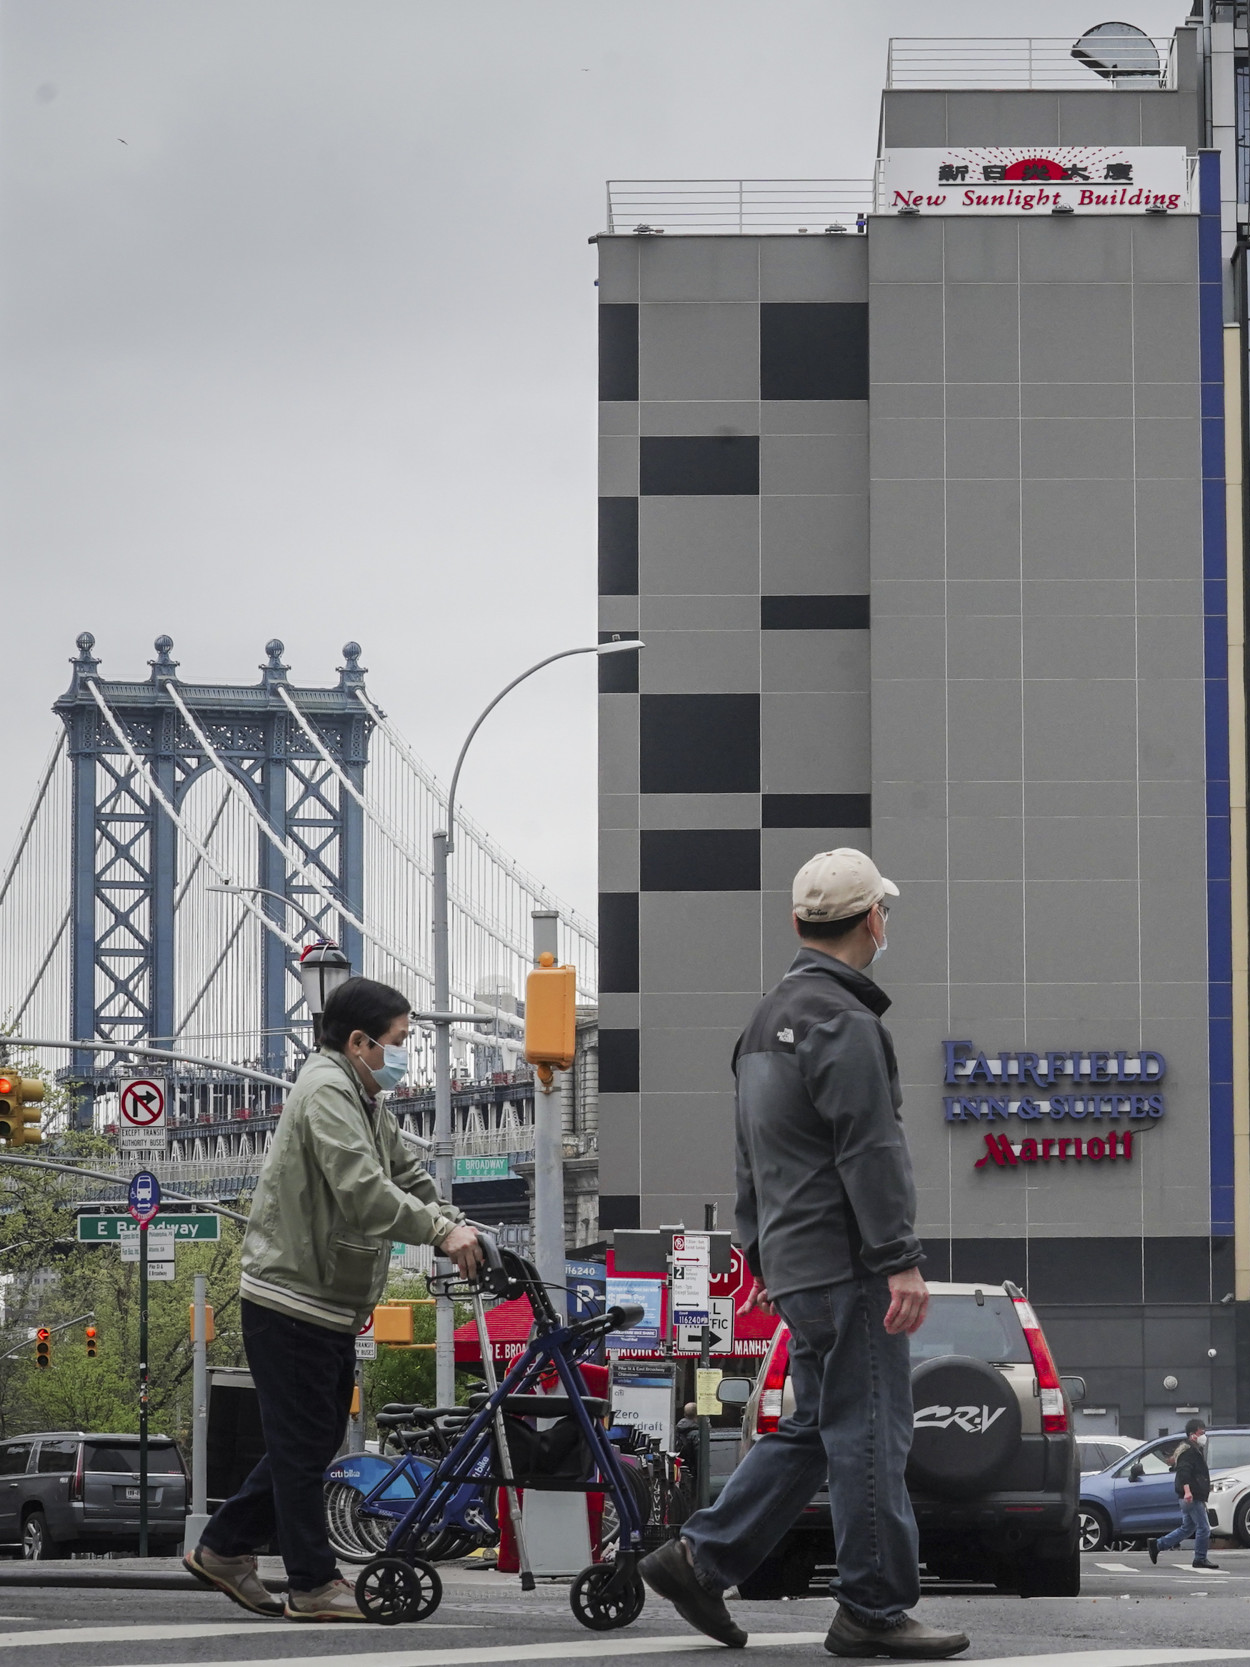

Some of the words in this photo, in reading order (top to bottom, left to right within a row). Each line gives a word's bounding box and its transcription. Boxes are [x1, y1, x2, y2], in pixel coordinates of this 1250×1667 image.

[892, 190, 947, 207] New
[962, 188, 1062, 210] Sunlight
[1078, 188, 1181, 210] Building
[943, 1096, 1011, 1120] INN
[1016, 1096, 1043, 1120] &
[1049, 1094, 1164, 1119] SUITES
[121, 1129, 141, 1137] EXCEPT
[143, 1129, 165, 1137] TRANSIT
[121, 1139, 147, 1147] AUTHORITY
[149, 1139, 165, 1147] BUSES
[974, 1130, 1133, 1168] Marriott
[456, 1160, 462, 1170] E
[465, 1159, 505, 1170] BROADWAY
[98, 1221, 108, 1235] E
[676, 1267, 682, 1278] 2
[615, 1409, 639, 1419] Zero
[330, 1469, 343, 1478] citi
[343, 1469, 360, 1478] bike
